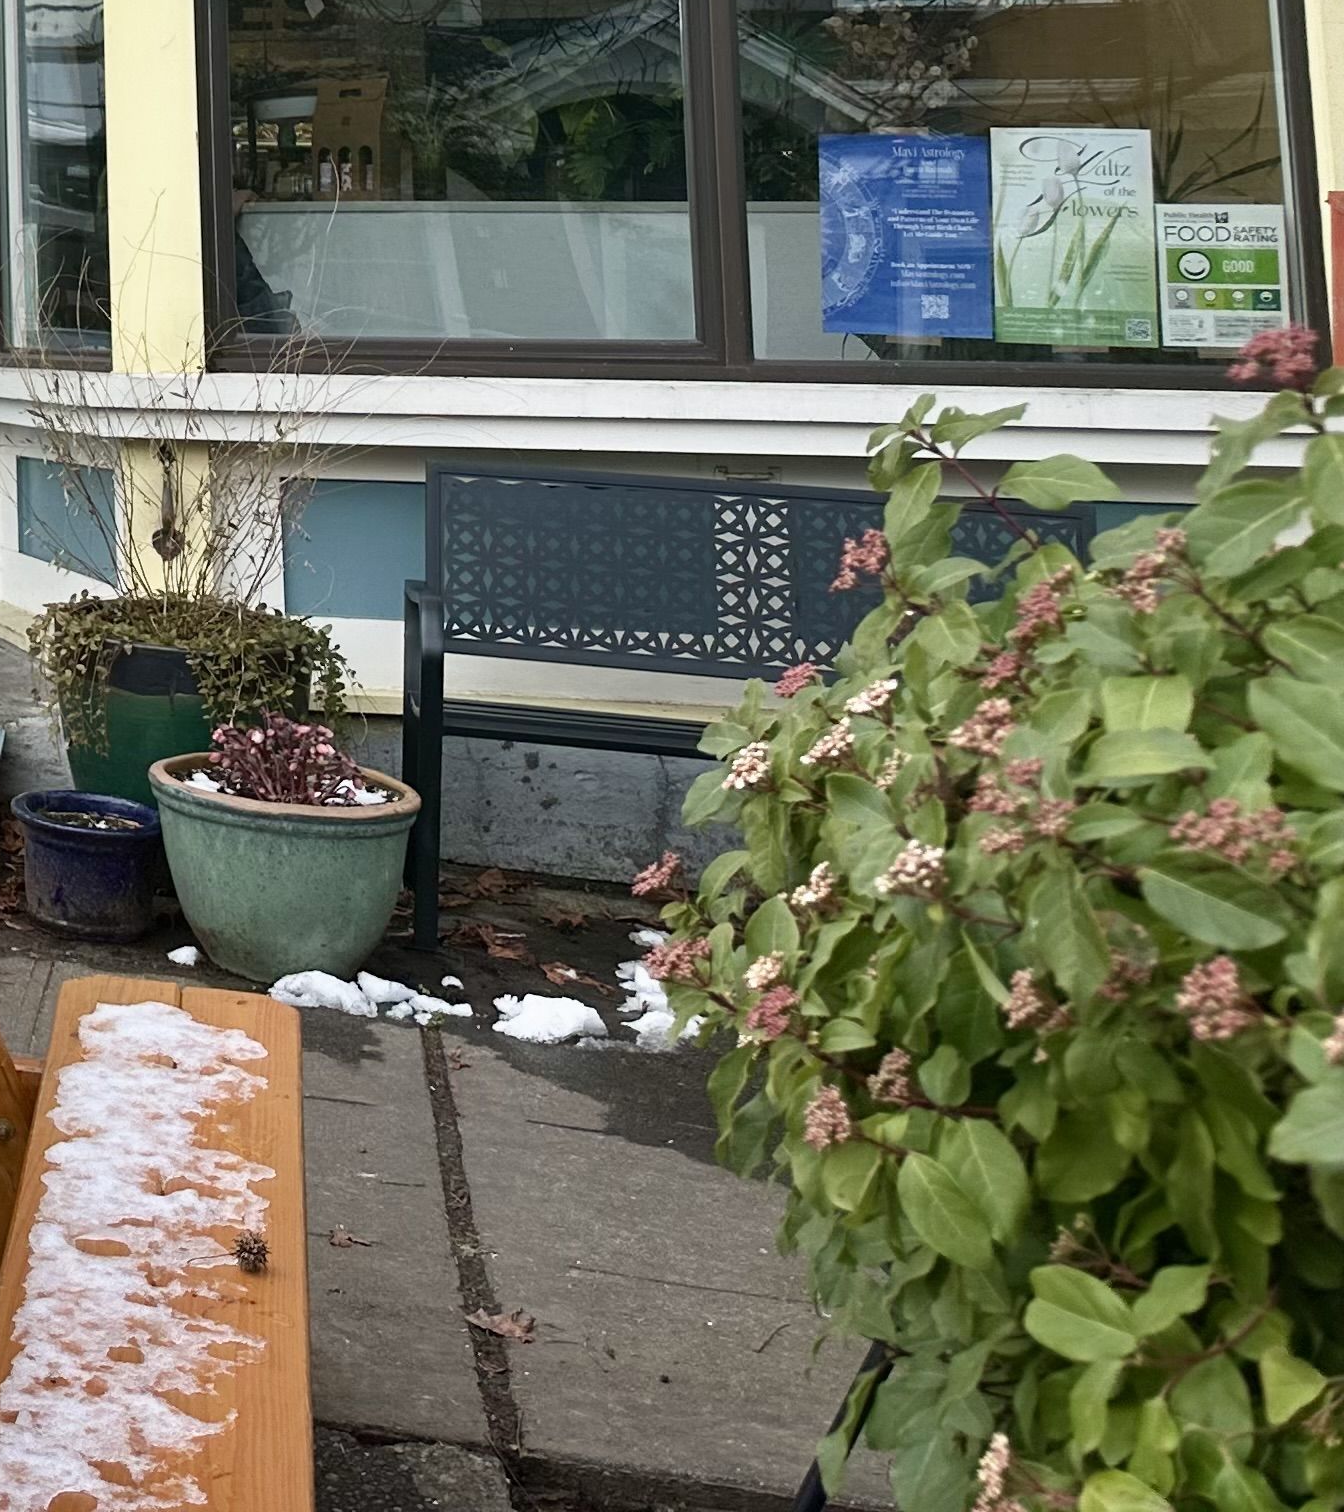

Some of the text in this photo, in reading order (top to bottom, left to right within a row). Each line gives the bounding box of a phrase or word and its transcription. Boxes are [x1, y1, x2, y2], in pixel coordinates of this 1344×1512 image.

[921, 147, 965, 161] Astrology
[1018, 135, 1133, 178] Waltz
[1103, 186, 1137, 197] of the
[1164, 225, 1278, 243] FOOD SAFETY
[1233, 234, 1279, 243] RATING
[1222, 260, 1255, 273] GOOD
